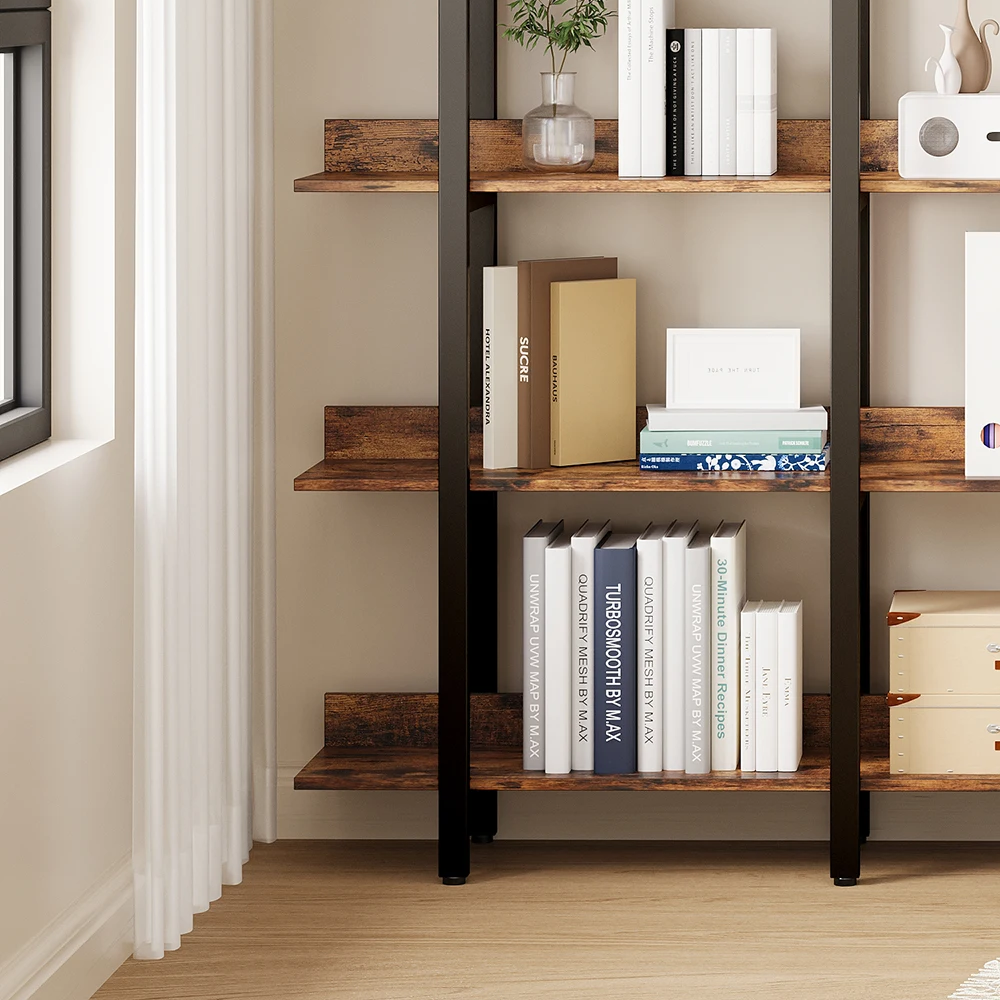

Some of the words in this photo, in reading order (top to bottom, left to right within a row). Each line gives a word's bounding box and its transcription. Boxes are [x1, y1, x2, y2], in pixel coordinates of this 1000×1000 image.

[672, 114, 677, 122] OF
[691, 123, 695, 131] AN
[519, 336, 529, 383] SUCRE
[529, 574, 540, 633] UNWRAP
[578, 573, 588, 643] QUADRIFY
[716, 558, 728, 628] 30-Minute
[644, 576, 654, 645] QUADRIFY
[691, 584, 702, 641] UNWRAP
[605, 583, 622, 686] TURBOSMOOTH
[529, 636, 540, 669] UVW
[578, 646, 588, 685] MESH
[644, 648, 654, 687] MESH
[691, 644, 702, 676] UVW
[716, 632, 728, 680] Dinner
[529, 671, 540, 700] MAP
[578, 688, 588, 706] BY
[605, 689, 622, 707] BY
[644, 690, 654, 708] BY
[691, 678, 702, 706] MAP
[529, 704, 540, 722] BY
[578, 710, 588, 743] M.AX
[605, 709, 622, 742] M.AX
[691, 709, 702, 727] BY
[714, 682, 727, 739] Recipes
[529, 725, 540, 758] M.AX
[644, 711, 654, 744] M.AX
[691, 730, 702, 762] M.AX
